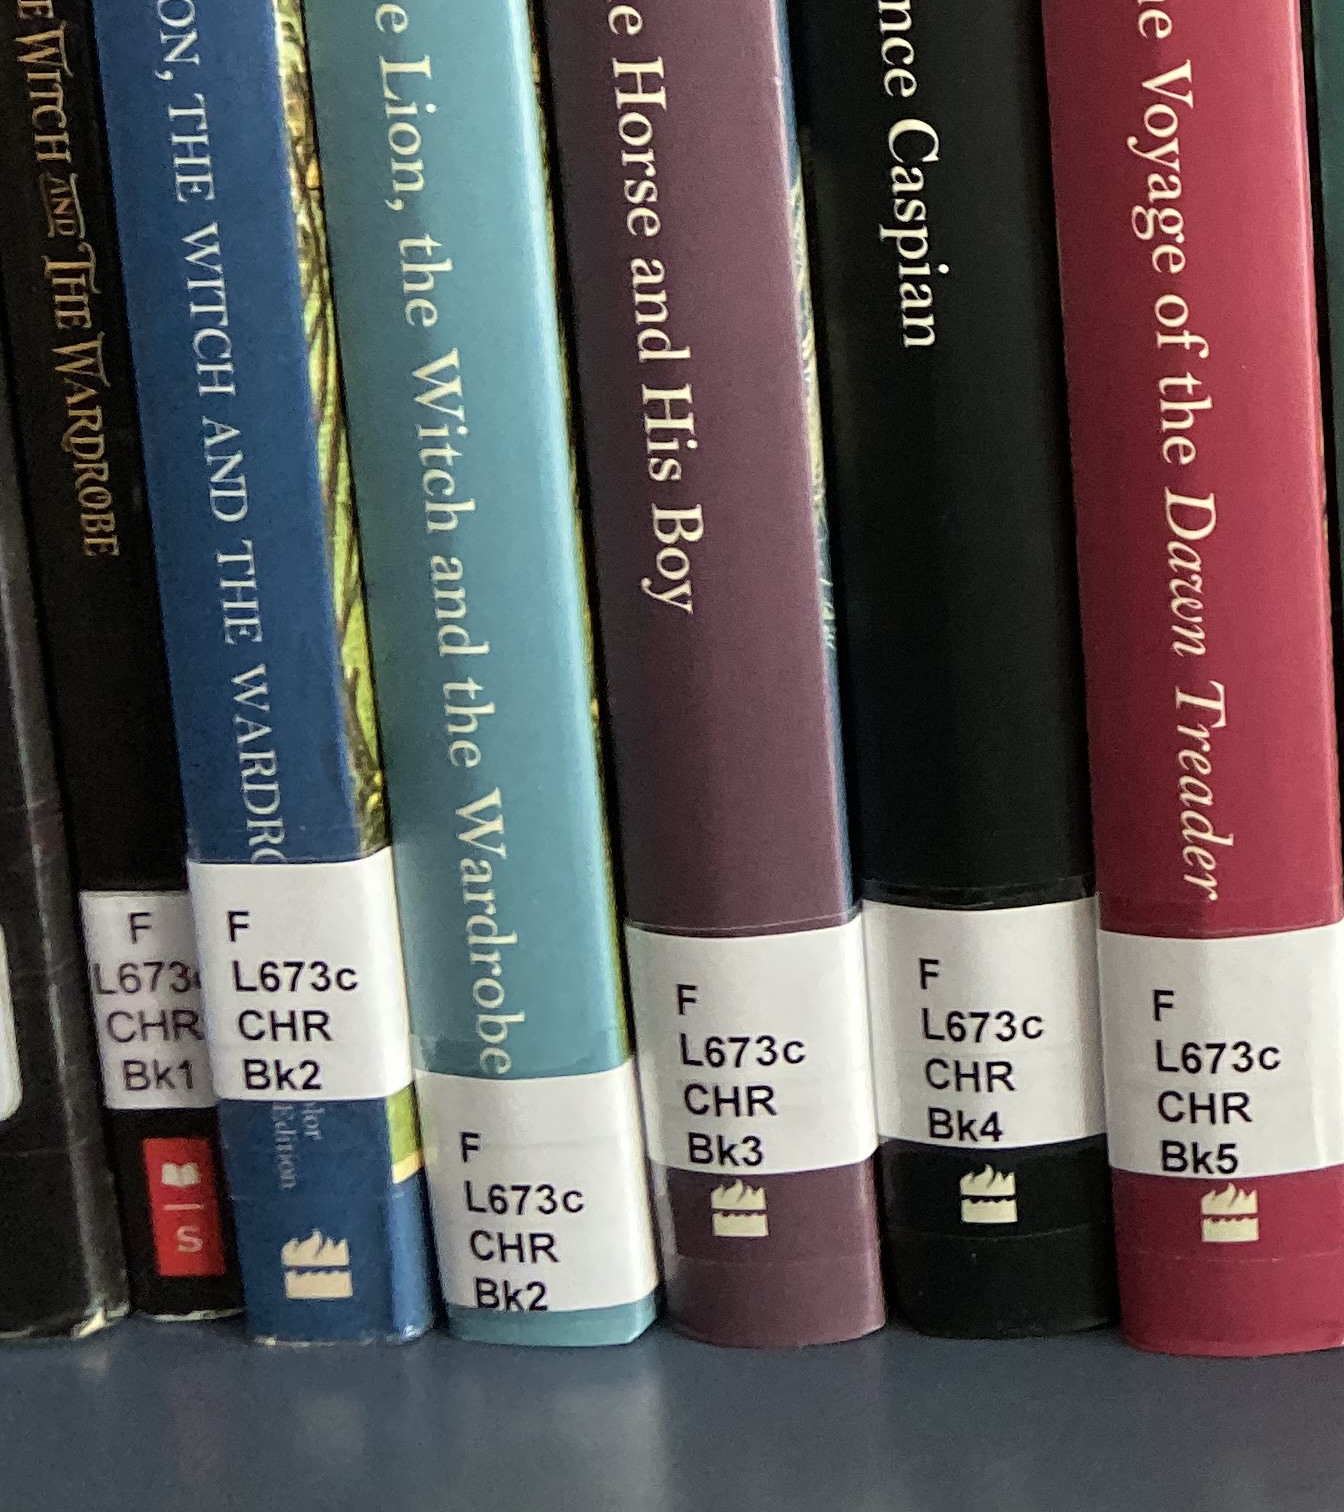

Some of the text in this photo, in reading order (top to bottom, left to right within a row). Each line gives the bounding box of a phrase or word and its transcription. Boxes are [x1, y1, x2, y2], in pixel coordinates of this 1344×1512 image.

[168, 93, 216, 204] THE
[611, 56, 667, 237] Horse
[878, 118, 950, 349] Caspian
[15, 21, 74, 163] WITCH
[52, 332, 120, 557] WARDROBE
[181, 221, 236, 396] WITCH
[640, 383, 699, 483] His
[1127, 60, 1234, 901] Voyage the Dawn Treader
[378, 55, 527, 1075] Lion, the Witch Wardrobe
[641, 503, 706, 614] Boy
[227, 911, 250, 942] F
[233, 961, 358, 992] L673c
[919, 958, 940, 989] F
[239, 1010, 333, 1043] CHR
[681, 1033, 806, 1068] L673c
[1156, 1040, 1281, 1074] L673c
[123, 1059, 194, 1091] Bk1
[243, 1059, 322, 1090] Bk2
[926, 1059, 1015, 1092] CHR
[928, 1107, 1003, 1142] Bk4
[688, 1133, 764, 1166] Bk3
[1161, 1140, 1238, 1174] Bk5
[474, 1277, 549, 1312] Bk2
